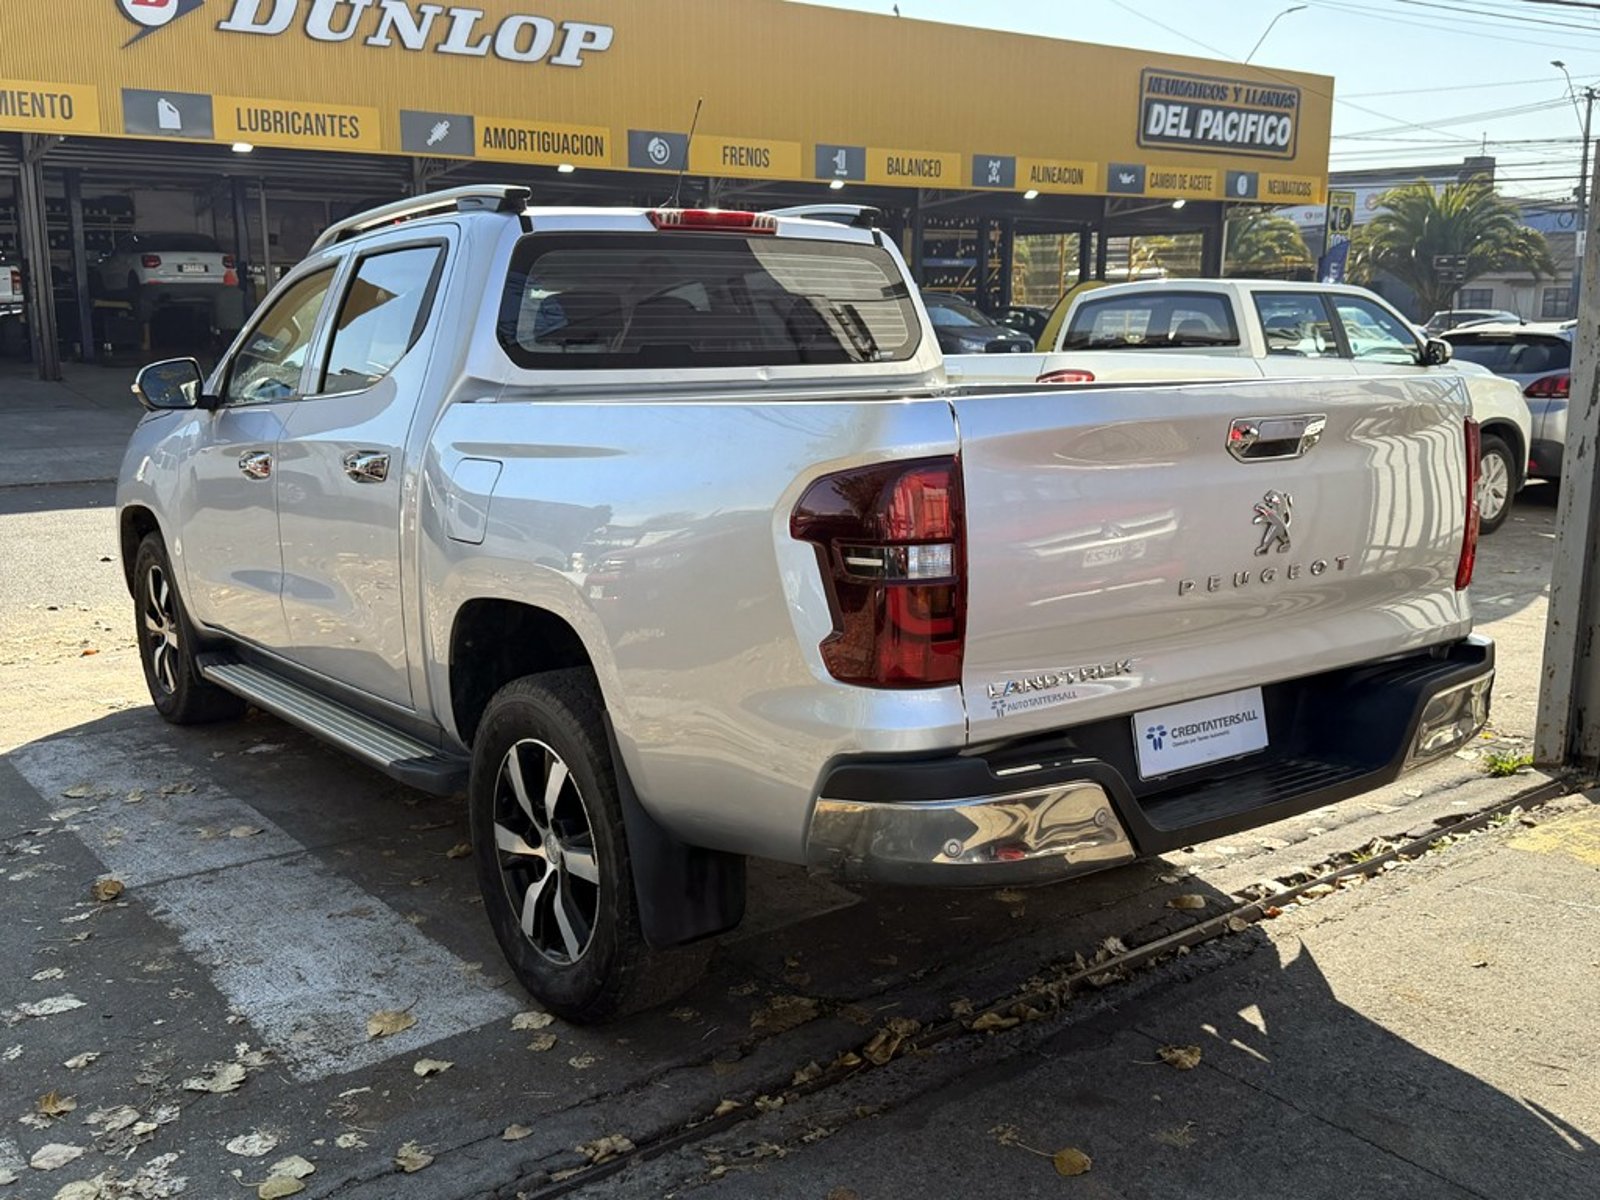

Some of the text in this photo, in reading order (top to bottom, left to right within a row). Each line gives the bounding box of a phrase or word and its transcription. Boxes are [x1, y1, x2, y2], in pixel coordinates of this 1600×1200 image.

[217, 0, 613, 67] DUNLOP
[1147, 76, 1295, 109] NEUMATICOS Y LLANTAS
[236, 107, 360, 139] LUBRICANTES
[1147, 103, 1292, 147] DEL PACIFICO
[483, 127, 604, 157] AMORTIGUACION
[722, 146, 770, 168] FRENOS
[887, 156, 942, 178] BALANCEO
[1030, 165, 1084, 185] ALINEACION
[1150, 172, 1212, 192] CAMBIO DE ACEITE
[1268, 179, 1312, 197] NEUMATICOS
[1179, 555, 1350, 596] PEUGEOT
[986, 658, 1132, 699] LANDTREK
[1006, 690, 1078, 712] AUTOTATTERSALL
[1171, 709, 1259, 739] CREDITATTERSALL
